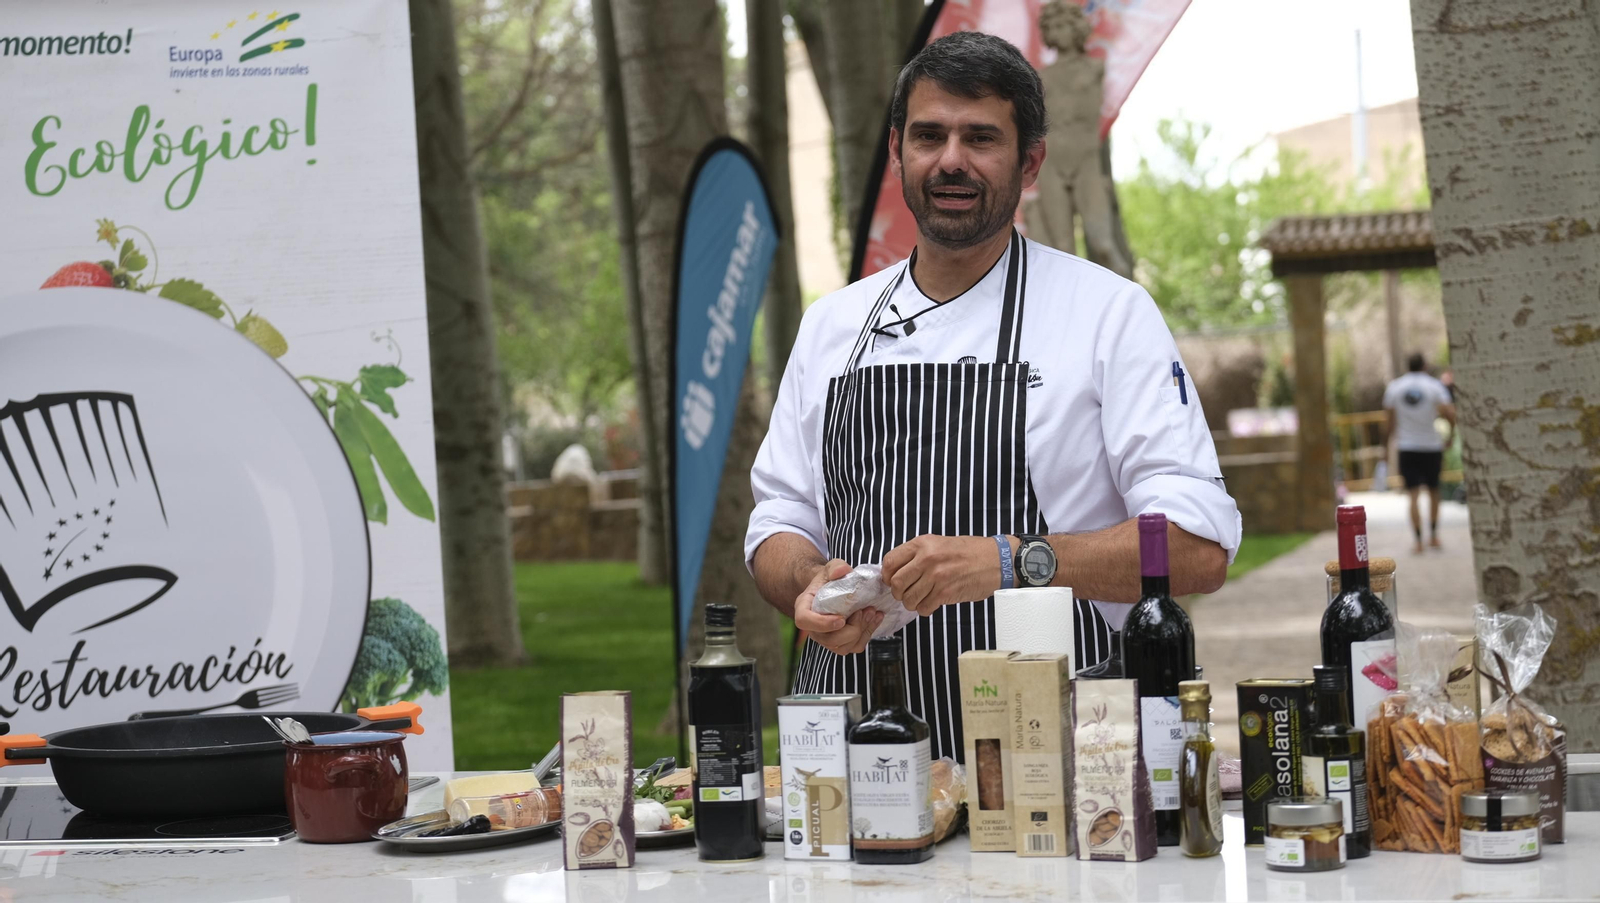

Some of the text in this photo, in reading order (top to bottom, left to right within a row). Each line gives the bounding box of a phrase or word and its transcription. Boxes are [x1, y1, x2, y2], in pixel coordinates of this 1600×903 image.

[0, 28, 133, 56] momento!
[169, 45, 223, 64] Europa
[169, 64, 309, 78] invierte en las zonas rurales
[24, 83, 317, 210] Ecológico!
[702, 201, 759, 378] cajamar
[782, 729, 836, 747] HABITAT
[852, 765, 910, 784] HABITAT
[811, 800, 821, 848] PICUAL
